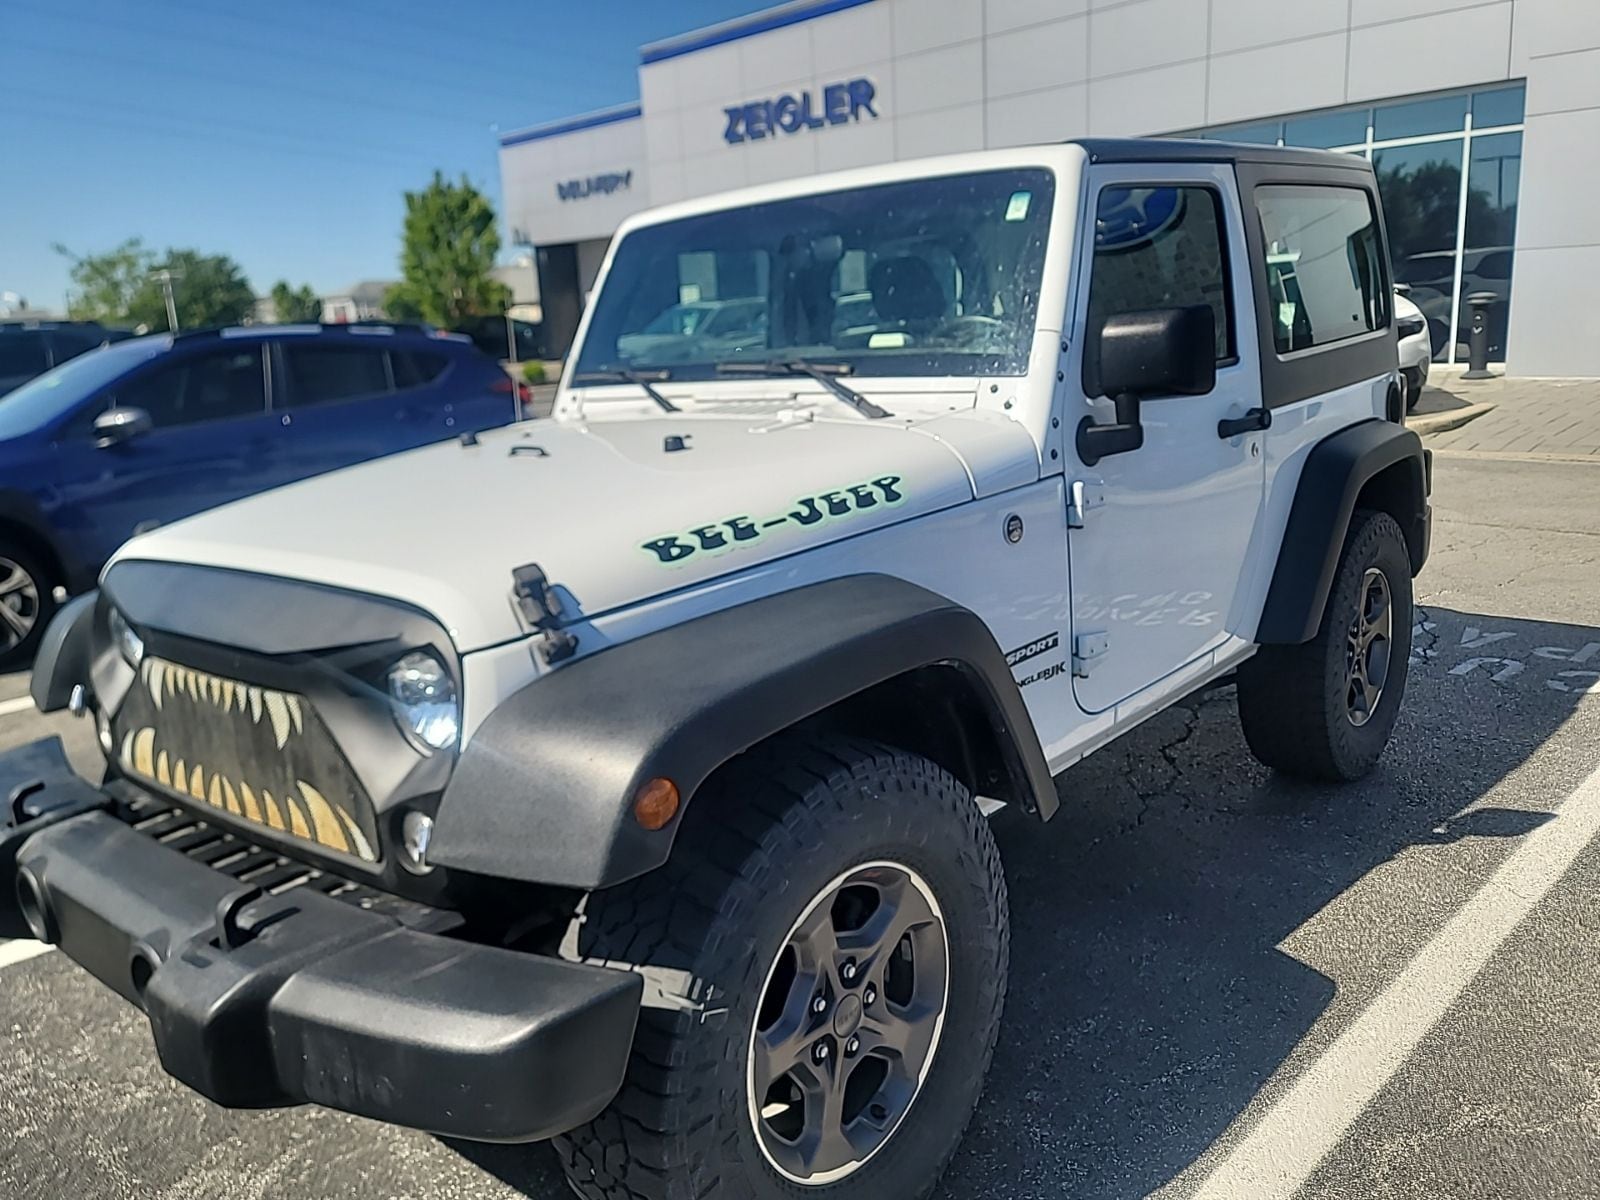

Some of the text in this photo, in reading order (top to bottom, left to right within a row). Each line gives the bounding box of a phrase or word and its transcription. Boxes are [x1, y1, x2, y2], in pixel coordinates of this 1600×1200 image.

[723, 78, 878, 144] ZEIGLER
[641, 475, 902, 563] BEE-JEEP
[1005, 635, 1058, 666] SPORT
